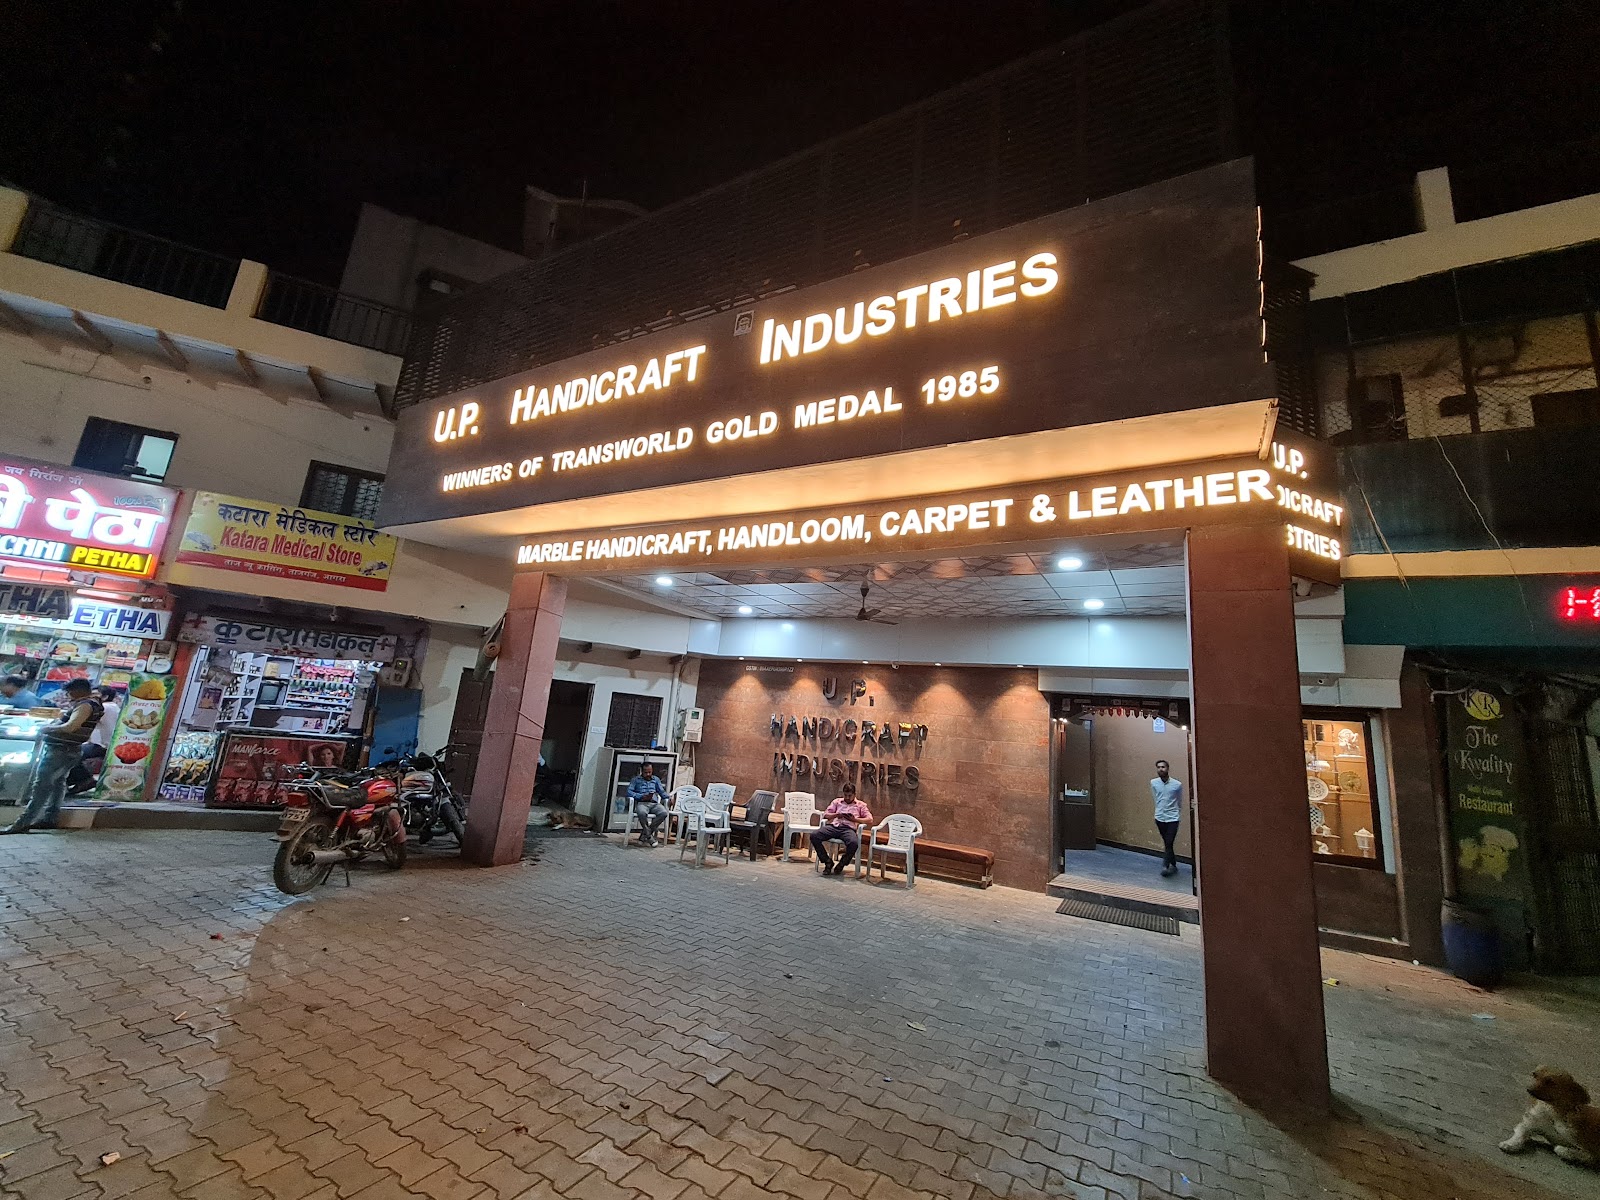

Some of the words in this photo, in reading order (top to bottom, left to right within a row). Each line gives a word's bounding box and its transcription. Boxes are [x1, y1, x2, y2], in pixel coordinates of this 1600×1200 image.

[434, 401, 480, 443] U.P.
[509, 345, 707, 425] HANDICRAFT
[759, 252, 1060, 365] INDUSTRIES
[442, 462, 512, 492] WINNERS
[518, 456, 544, 478] OF
[551, 427, 694, 472] TRANSWORLD
[705, 411, 778, 444] GOLD
[794, 386, 903, 429] MEDAL
[921, 365, 1000, 405] 1985
[46, 488, 165, 548] पेठा
[217, 503, 270, 528] कटारा
[276, 507, 339, 540] मेडिकल
[343, 521, 380, 546] स्टोर
[517, 540, 585, 566] MARBLE
[585, 530, 713, 561] HANDICRAFT,
[717, 513, 872, 551] HANDLOOM,
[879, 498, 1013, 537] CARPET
[1029, 494, 1057, 524] &
[1069, 468, 1275, 520] LEATHER
[71, 546, 142, 570] PETHA
[220, 525, 269, 553] Katara
[271, 533, 325, 561] Medical
[326, 543, 363, 567] Store
[52, 604, 162, 634] ETHA
[770, 713, 929, 747] HANDICRAFT
[1466, 725, 1500, 749] The
[773, 752, 920, 790] INDUSTRIES
[1454, 749, 1514, 785] Kwality
[1459, 794, 1514, 815] Restaurant
